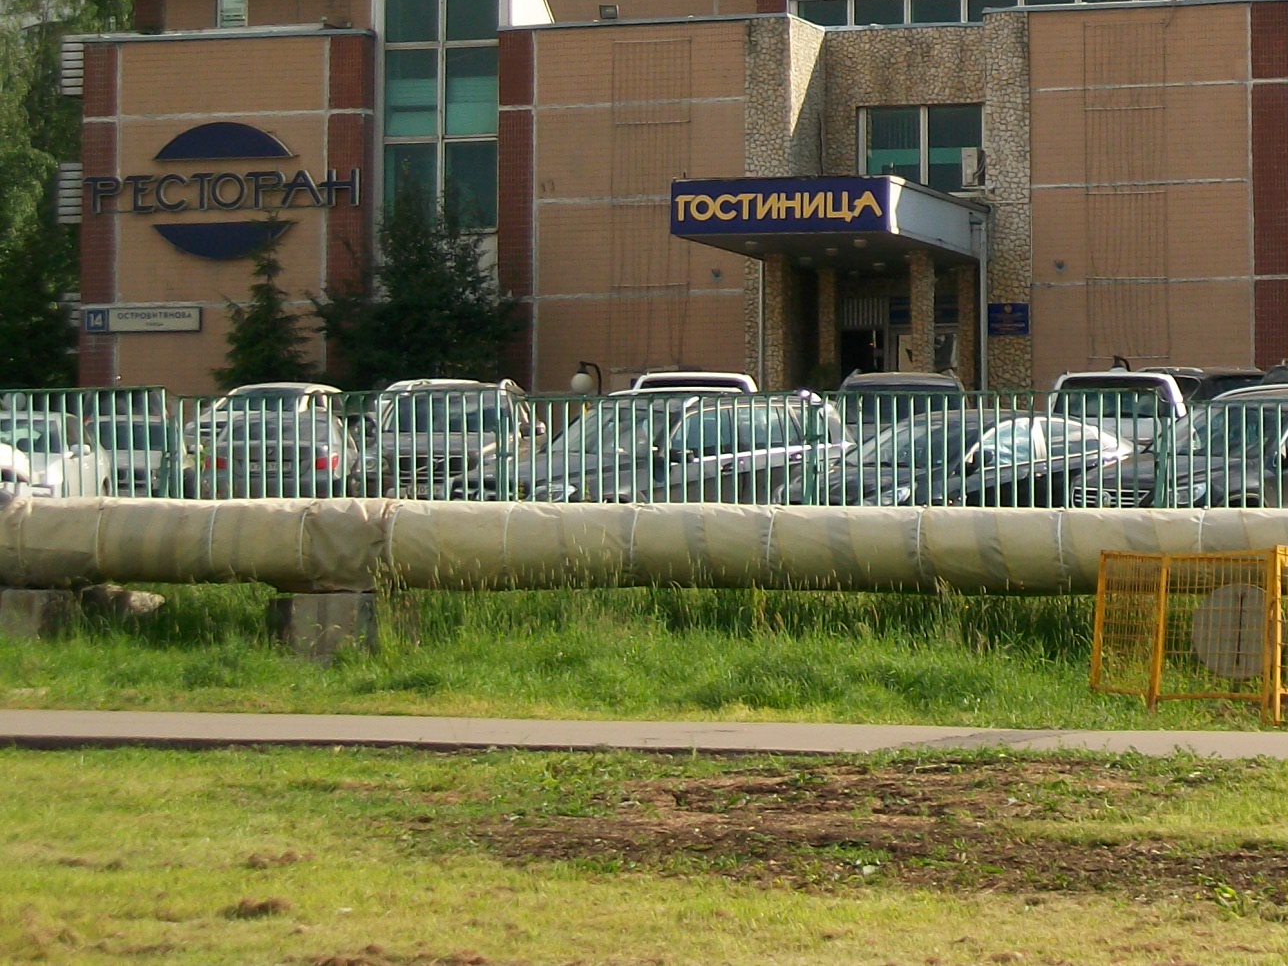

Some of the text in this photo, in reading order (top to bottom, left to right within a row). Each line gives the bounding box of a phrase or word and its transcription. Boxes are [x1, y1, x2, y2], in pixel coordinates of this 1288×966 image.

[83, 167, 361, 215] РЕСТОРАН
[674, 190, 883, 223] ГОСТИНИЦА
[89, 313, 103, 327] 14
